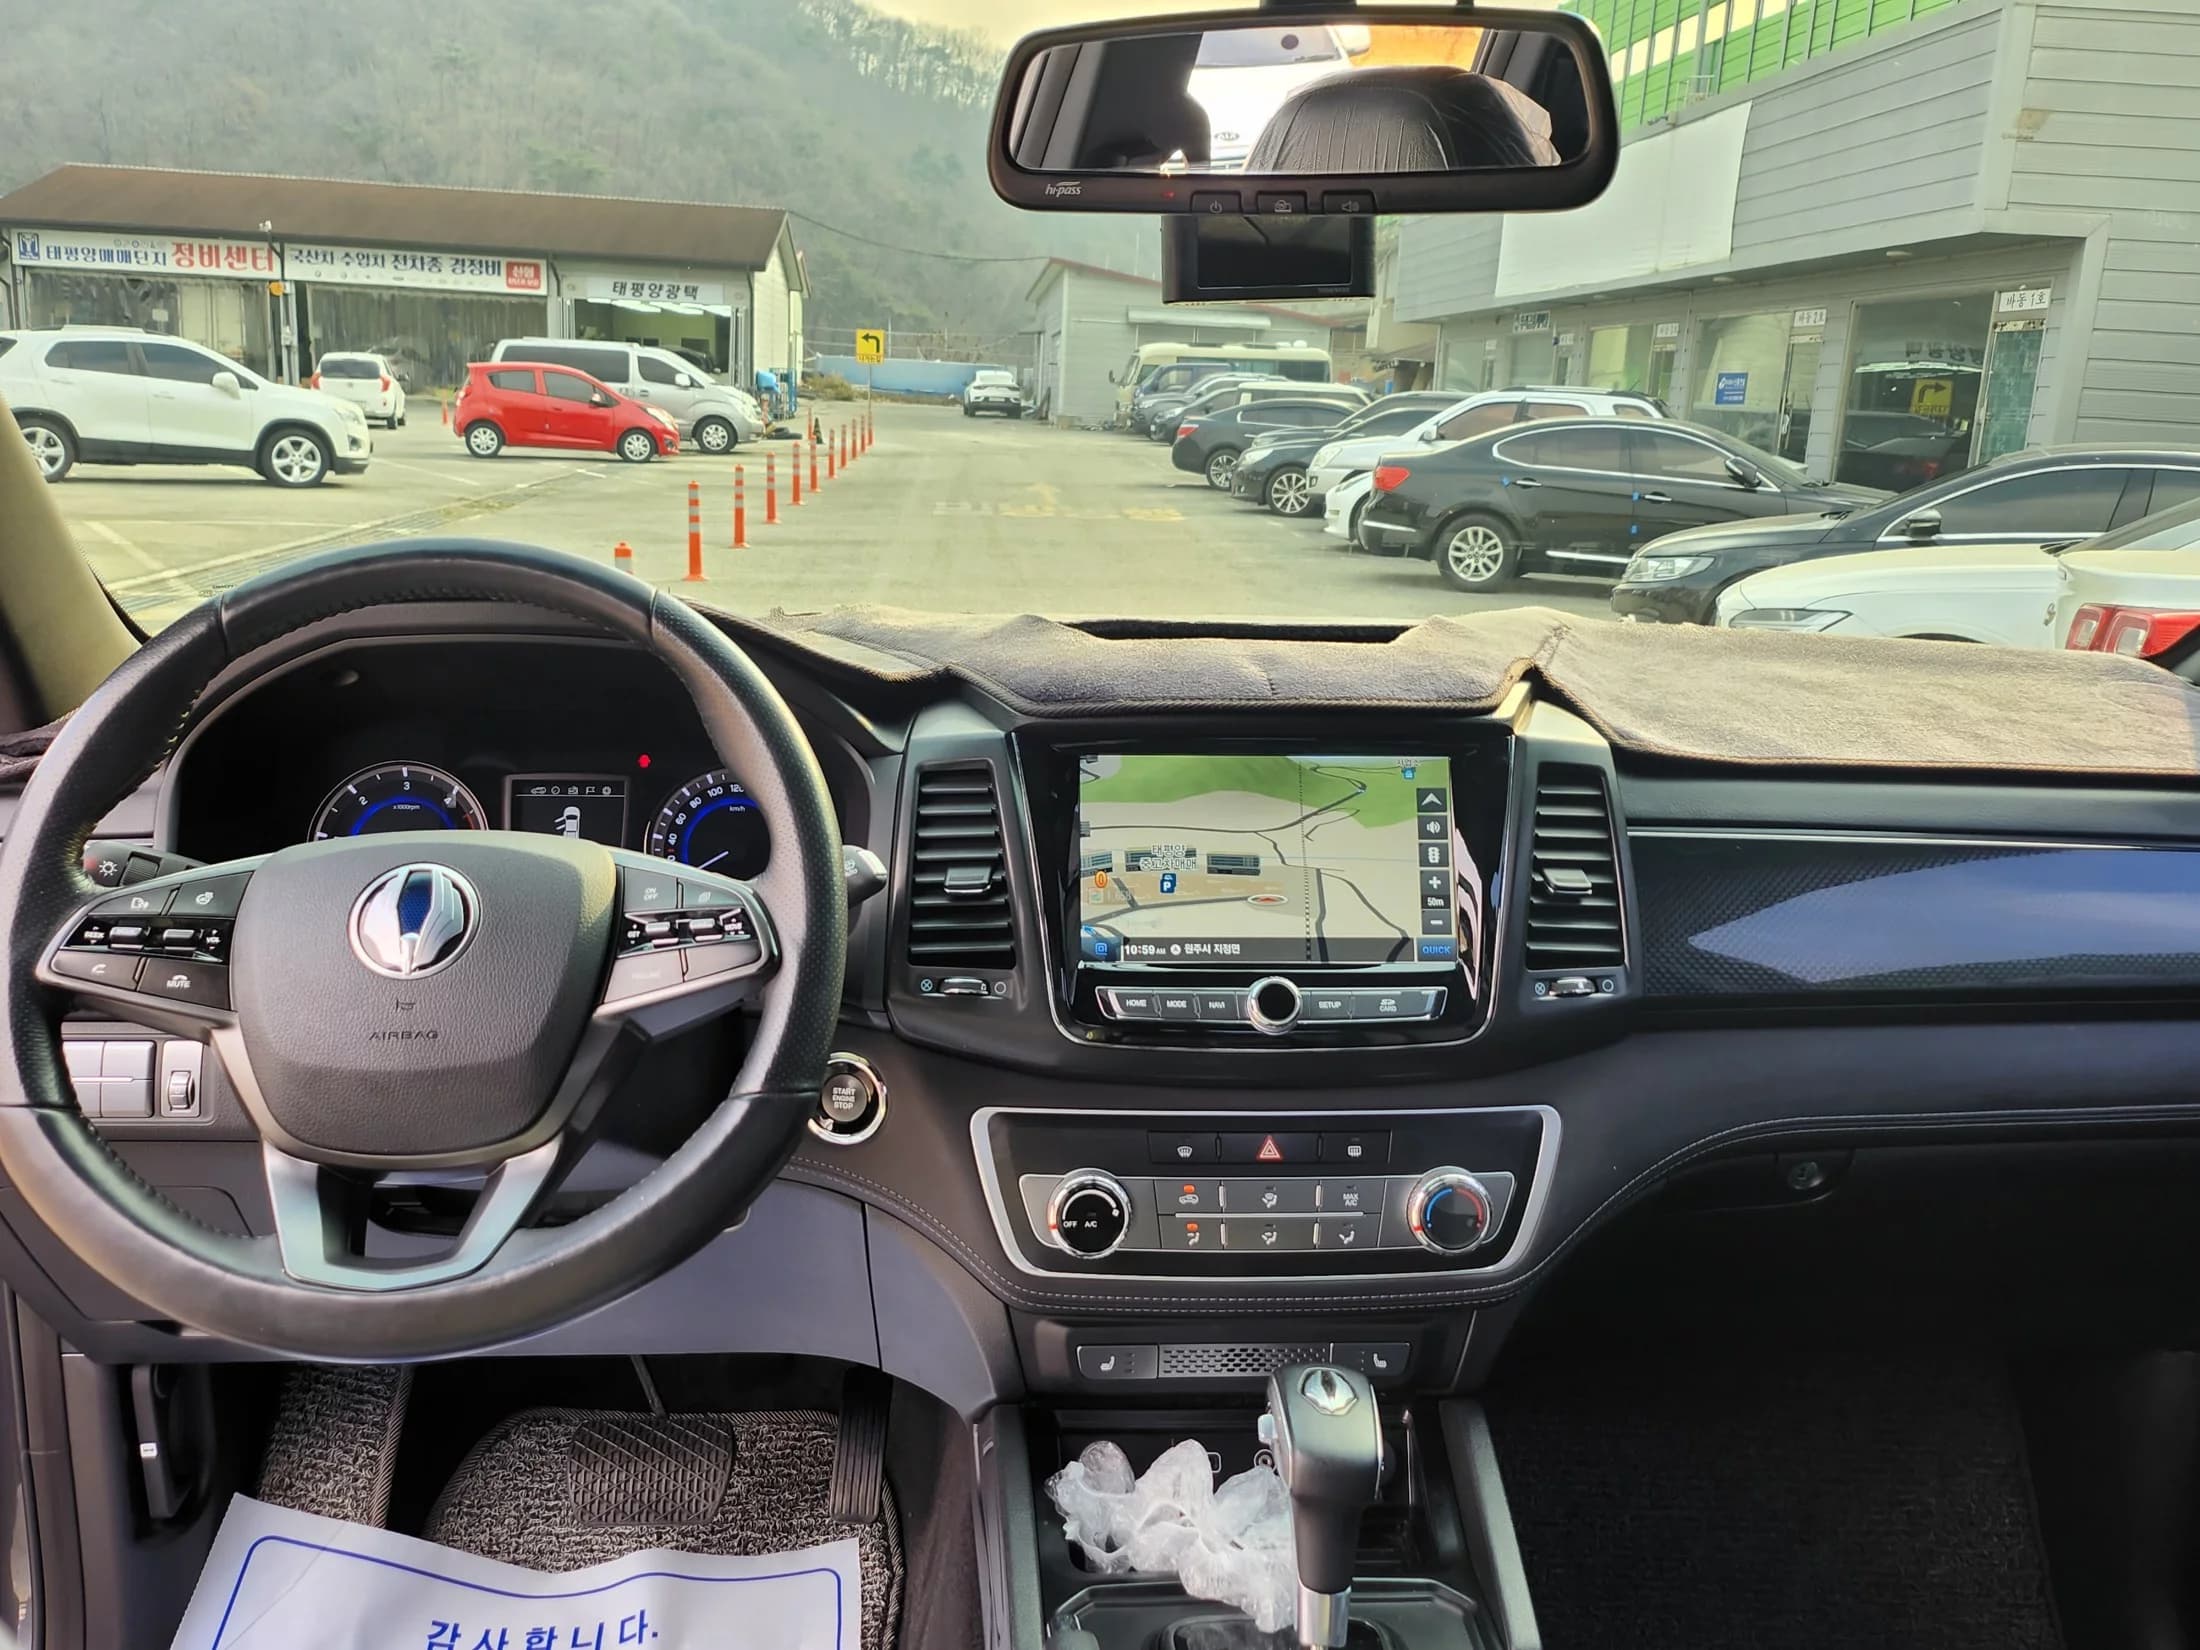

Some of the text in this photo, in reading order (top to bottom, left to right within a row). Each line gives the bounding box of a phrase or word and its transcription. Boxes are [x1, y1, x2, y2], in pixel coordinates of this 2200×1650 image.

[46, 241, 274, 272] 태평양매매단지 정비센터
[612, 280, 699, 299] 태평양광택
[403, 781, 411, 791] 3
[707, 786, 724, 798] 100
[358, 796, 369, 806] 2
[443, 797, 452, 806] 4
[689, 796, 702, 809] 80
[675, 812, 687, 825] 60
[668, 833, 677, 846] 40
[1152, 845, 1186, 857] 태평양
[1427, 897, 1445, 907] 50m
[206, 936, 221, 944] VOL
[1184, 943, 1211, 955] 원주시
[1213, 943, 1241, 955] 지정면
[1422, 946, 1451, 954] QUICK
[166, 980, 191, 989] MUTE
[1126, 999, 1147, 1008] HOME
[1166, 999, 1187, 1009] MODE
[1208, 1000, 1226, 1009] NAVI
[1318, 1000, 1342, 1009] SETUP
[369, 1030, 438, 1041] AIRBAG
[832, 1087, 856, 1096] START
[832, 1094, 856, 1103] ENGINE
[833, 1101, 854, 1109] STOP
[1063, 1220, 1078, 1228] OFF
[1084, 1220, 1098, 1228] A/C
